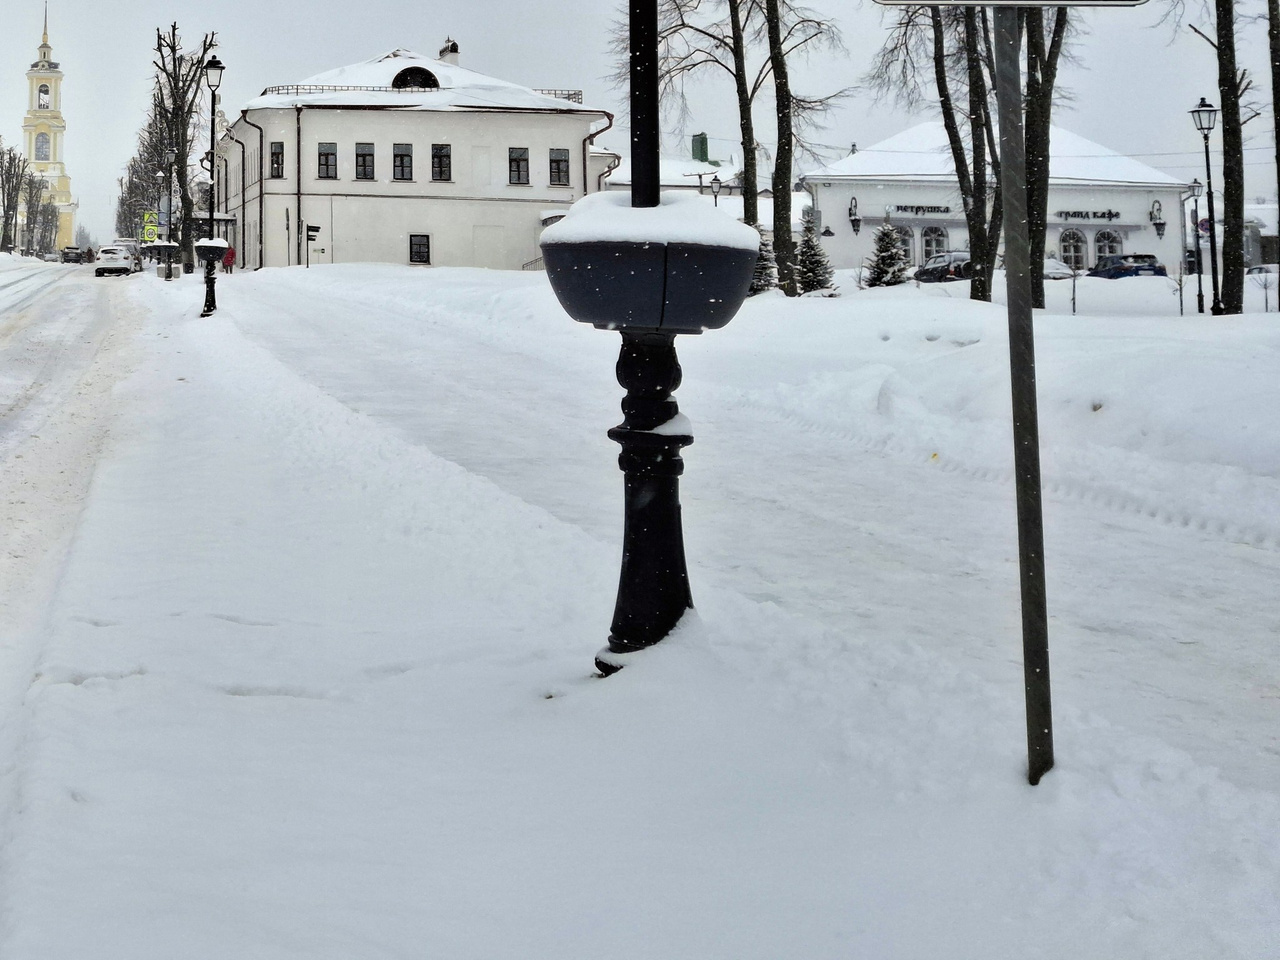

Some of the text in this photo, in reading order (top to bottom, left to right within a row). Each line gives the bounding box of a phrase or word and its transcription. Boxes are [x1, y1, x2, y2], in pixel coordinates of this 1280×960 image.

[896, 205, 950, 215] петрушка
[1059, 209, 1120, 221] гранд кафе
